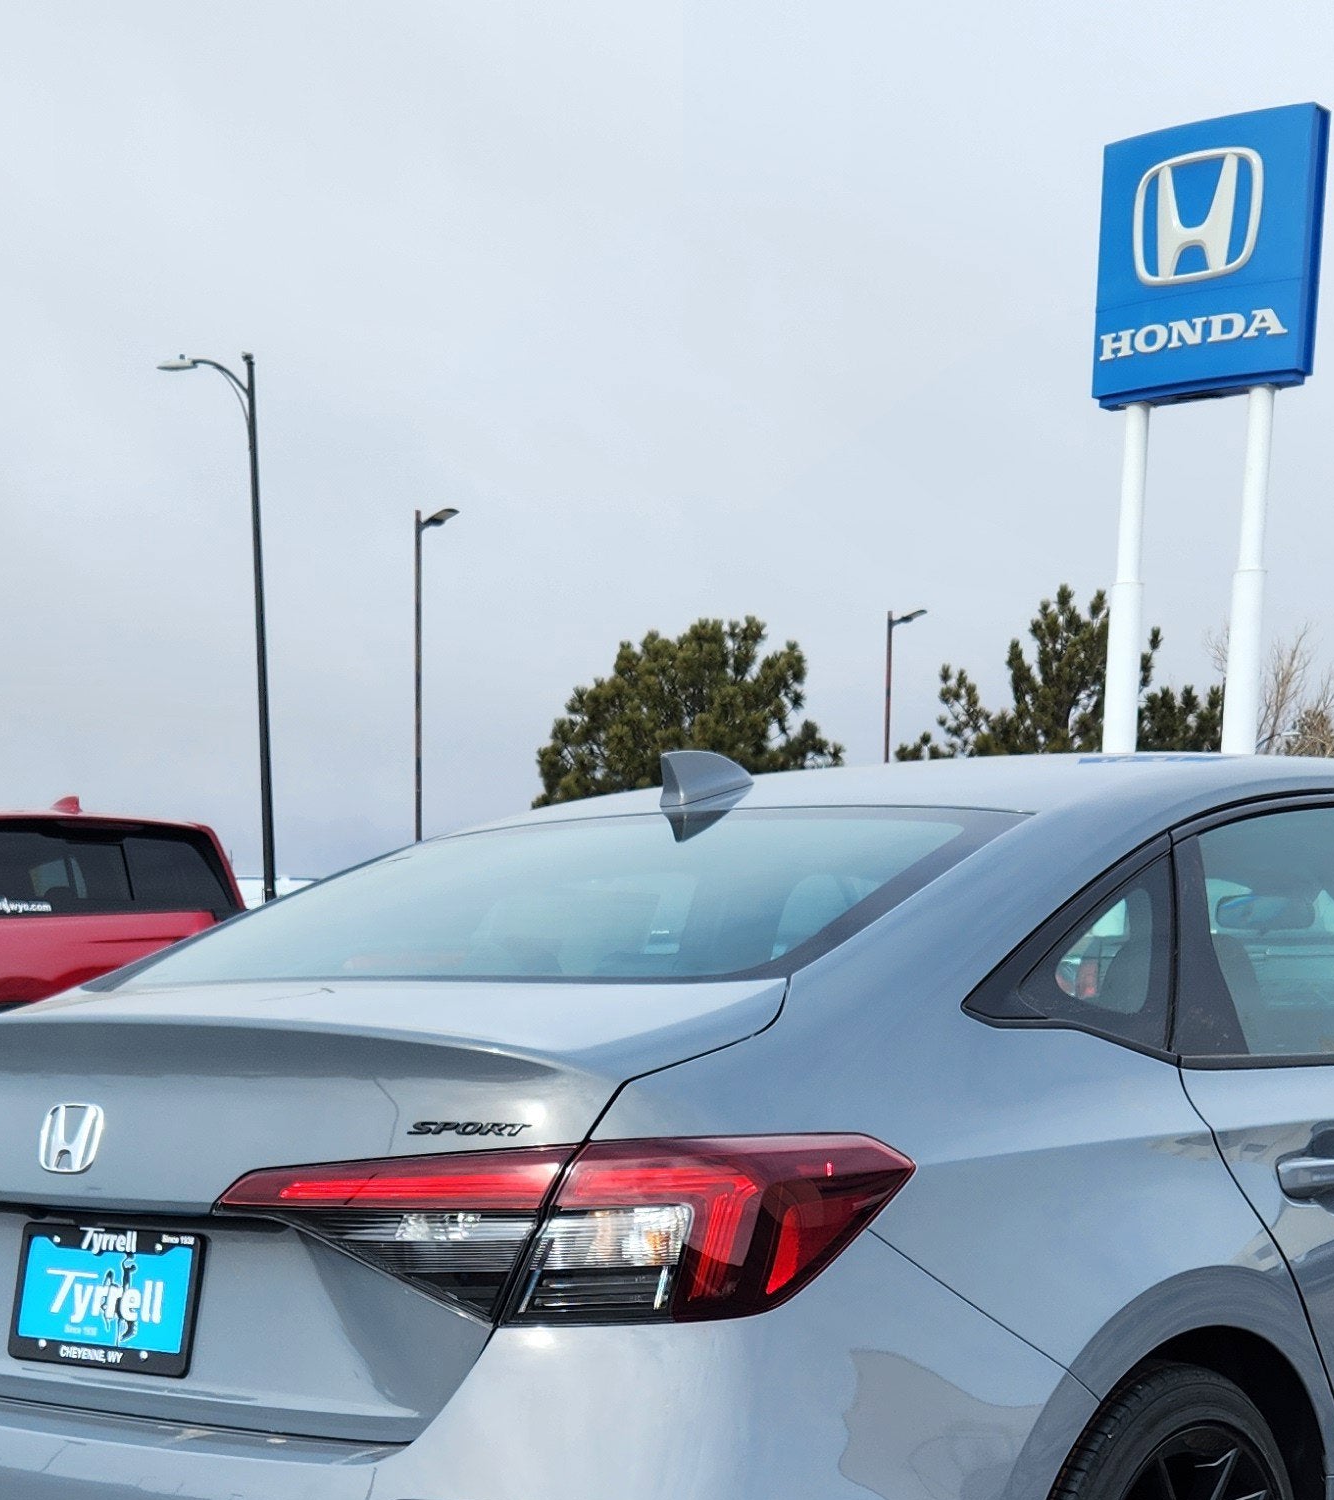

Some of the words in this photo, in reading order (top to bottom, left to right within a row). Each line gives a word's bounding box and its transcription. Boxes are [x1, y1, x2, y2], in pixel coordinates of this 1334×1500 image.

[1099, 308, 1288, 361] HONDA
[407, 1121, 533, 1137] SPORT
[79, 1227, 138, 1254] Tyrrell
[47, 1268, 164, 1324] Tyrrell
[107, 1351, 124, 1364] WY
